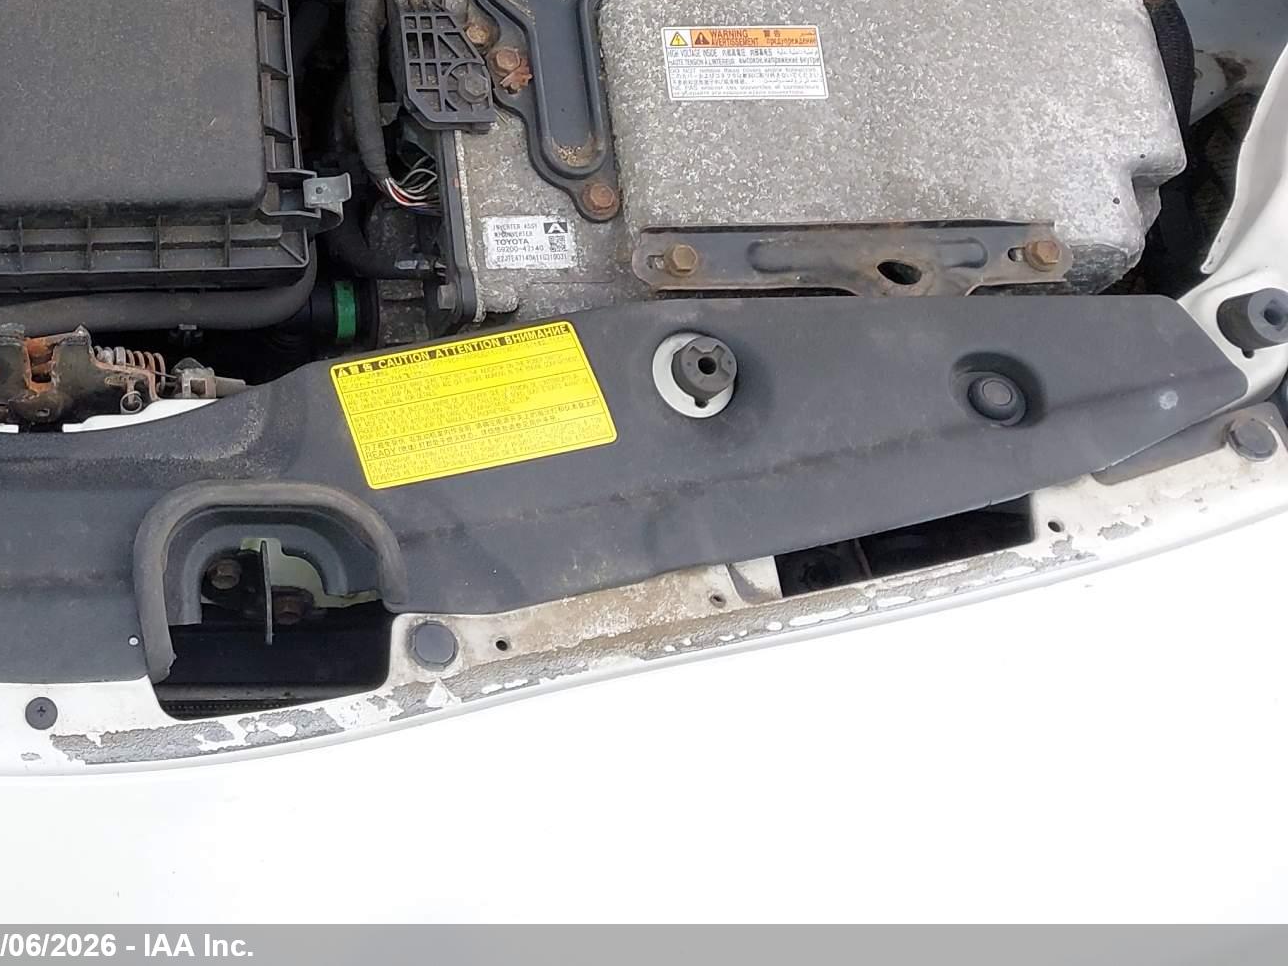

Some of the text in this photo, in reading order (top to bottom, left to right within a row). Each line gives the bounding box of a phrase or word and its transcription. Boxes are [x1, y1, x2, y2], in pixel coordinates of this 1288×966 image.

[710, 30, 748, 38] WARNING
[378, 351, 430, 369] CAUTION
[435, 339, 500, 358] ATTENTION
